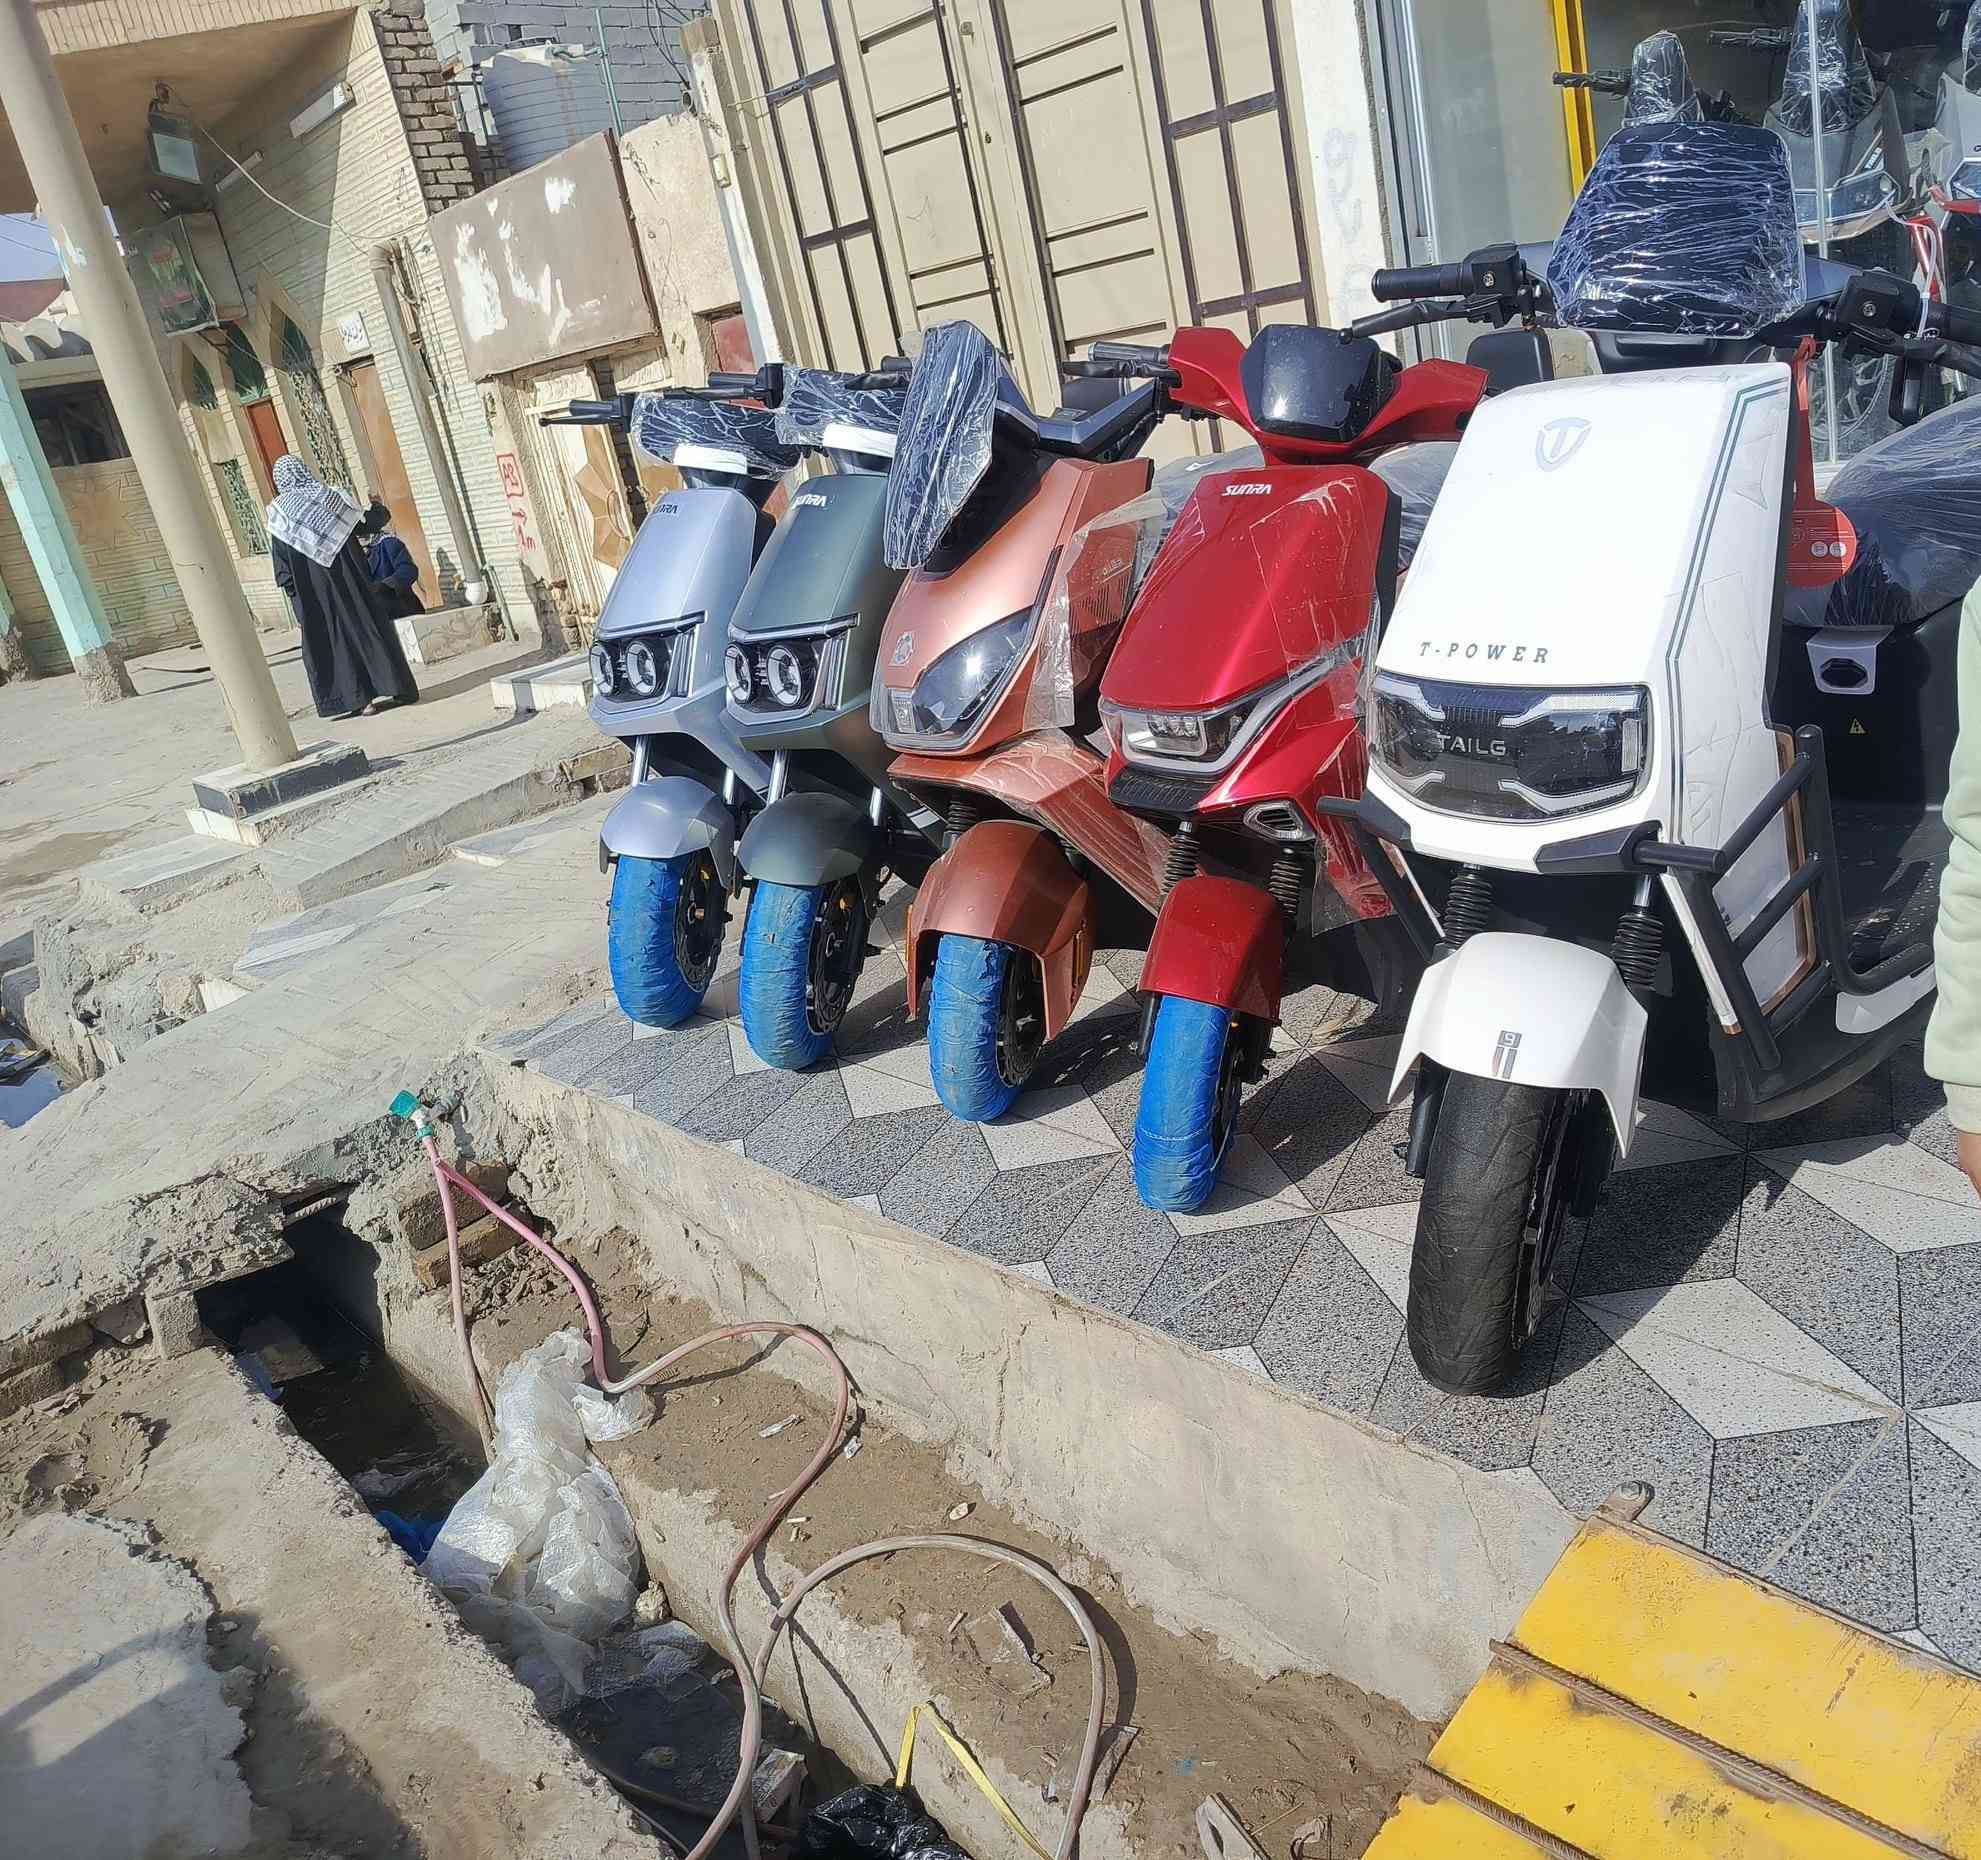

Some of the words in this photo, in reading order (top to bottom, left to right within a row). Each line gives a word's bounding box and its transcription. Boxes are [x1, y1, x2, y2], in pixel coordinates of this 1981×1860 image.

[1221, 483, 1272, 497] SUNRA
[1420, 641, 1549, 664] T-POWER
[1436, 734, 1506, 756] TAILG
